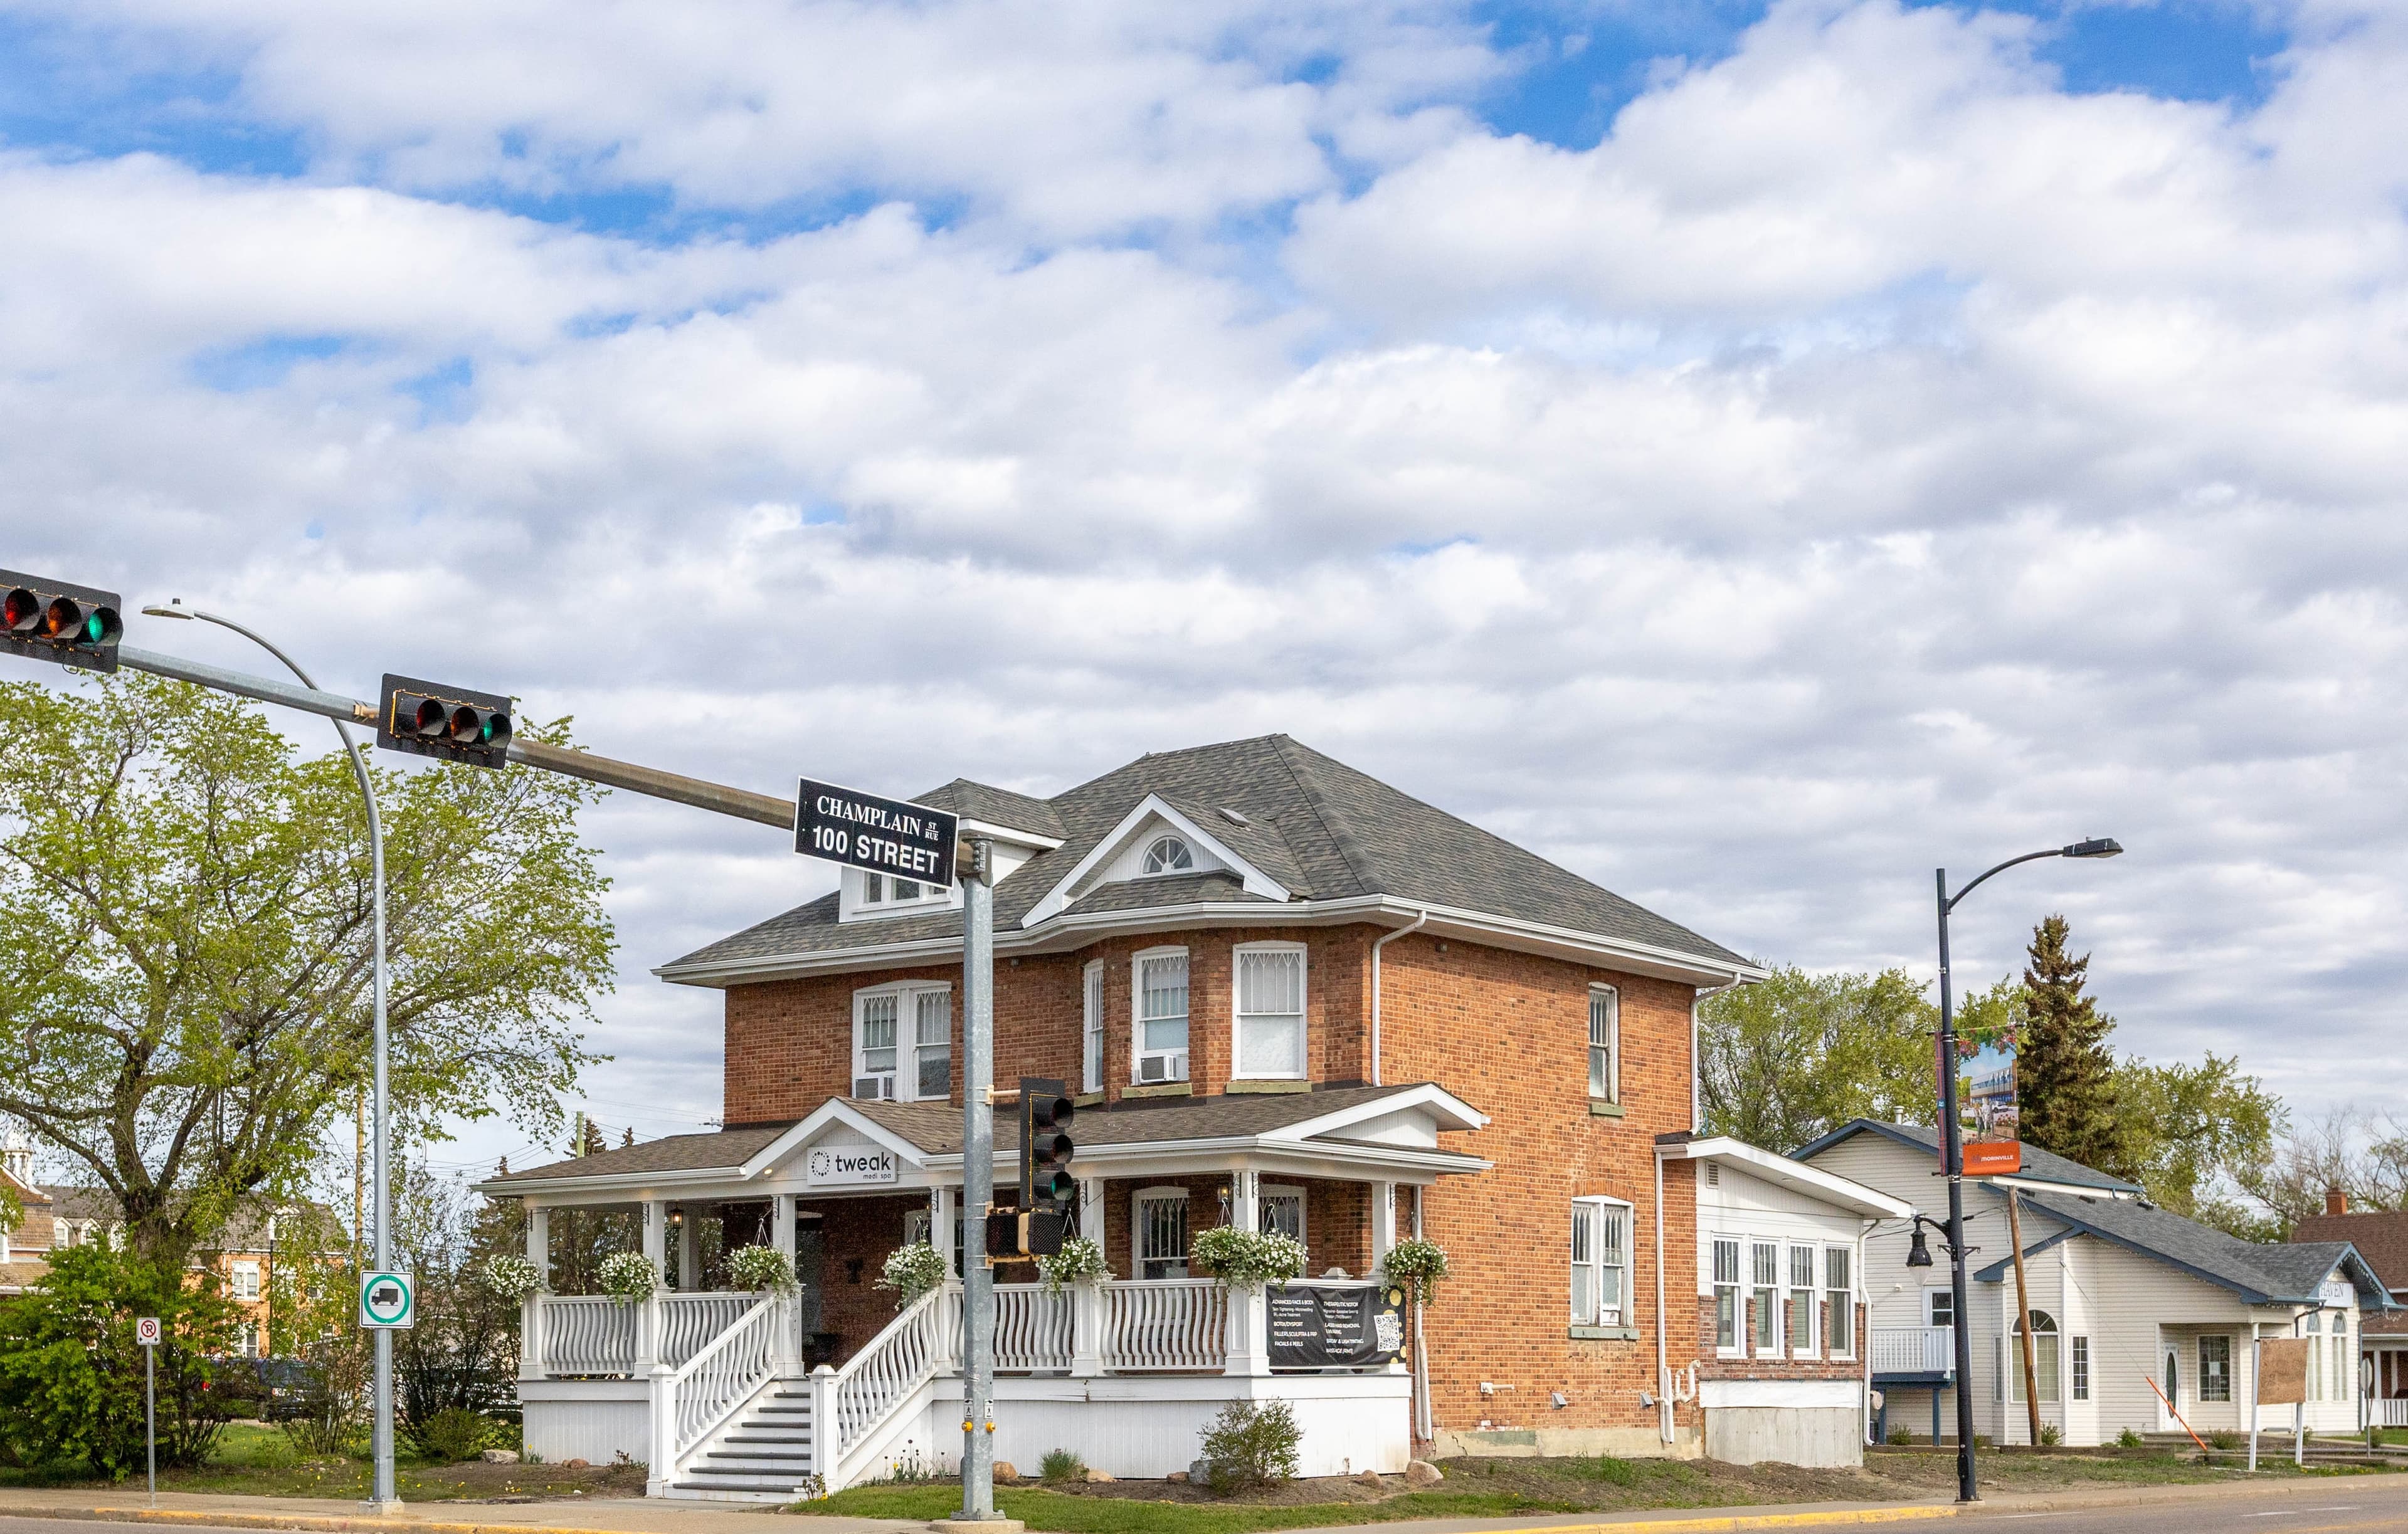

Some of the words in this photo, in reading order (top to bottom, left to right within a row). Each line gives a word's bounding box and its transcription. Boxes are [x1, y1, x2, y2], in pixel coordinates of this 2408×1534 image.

[817, 796, 921, 836] CHAMPLAIN
[925, 832, 939, 841] RUE
[813, 826, 848, 854] 100
[857, 835, 939, 874] STREET
[835, 1152, 890, 1172] tweak
[2321, 1283, 2344, 1298] HAVEN
